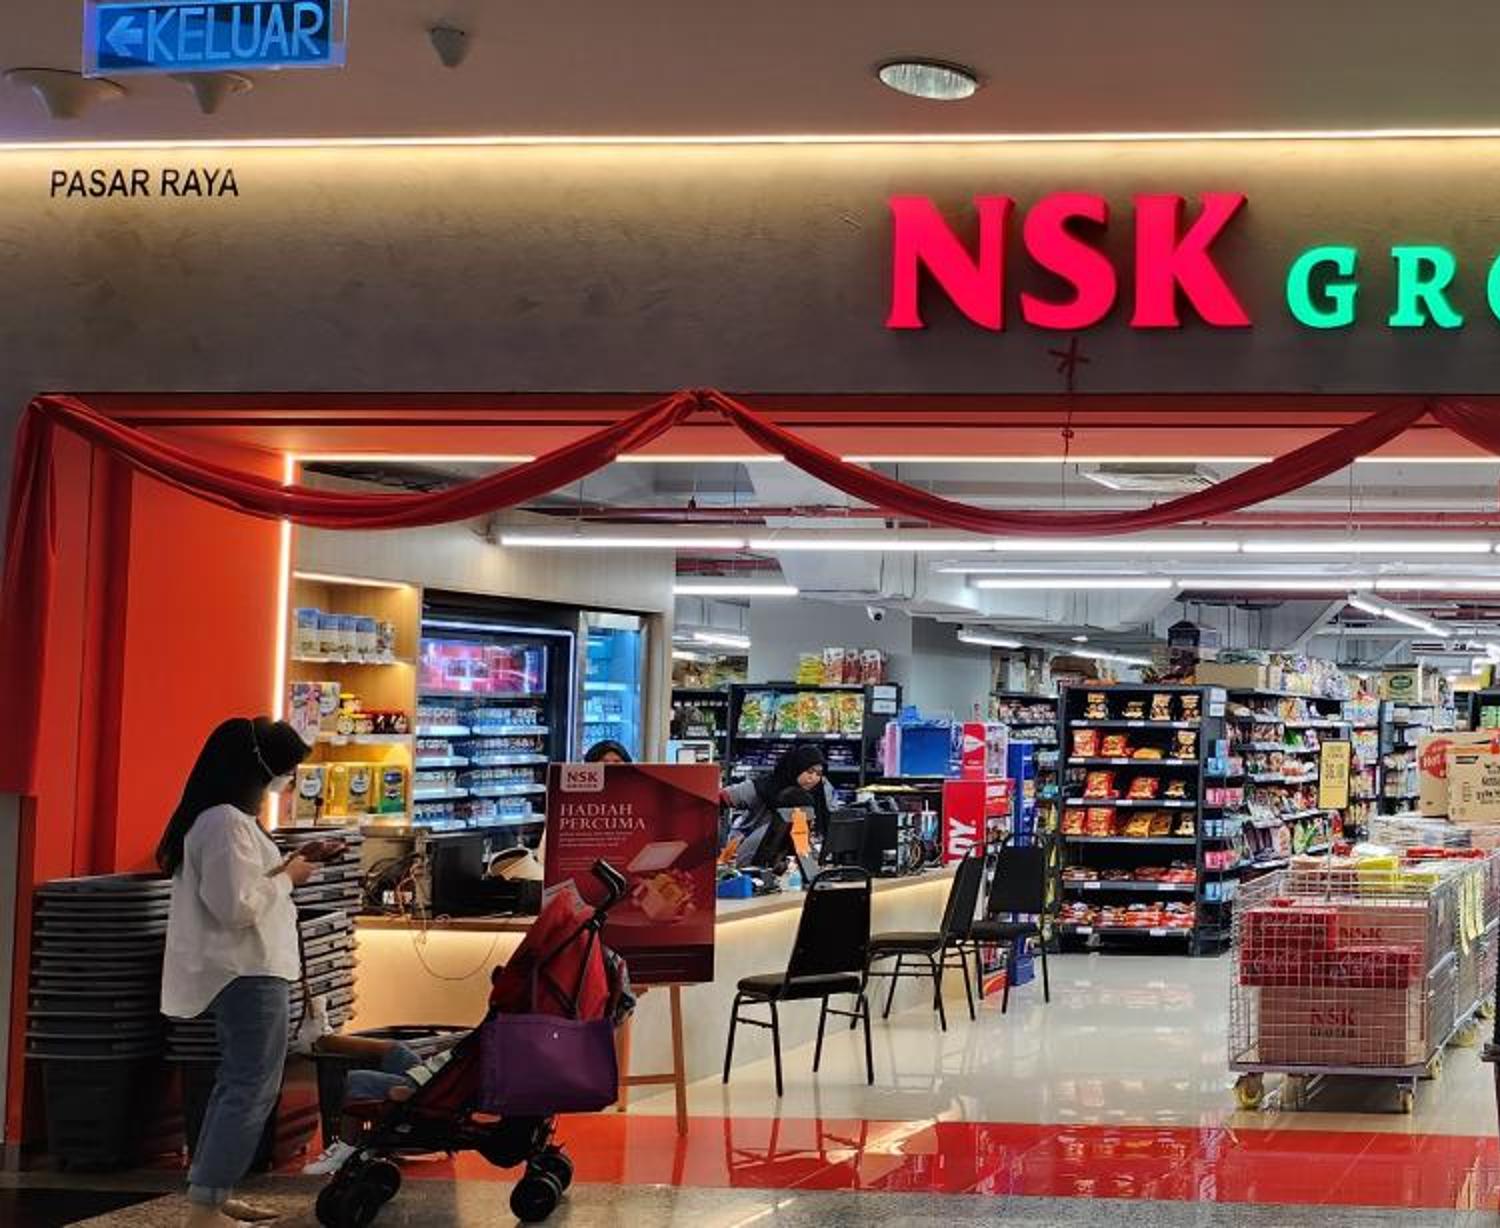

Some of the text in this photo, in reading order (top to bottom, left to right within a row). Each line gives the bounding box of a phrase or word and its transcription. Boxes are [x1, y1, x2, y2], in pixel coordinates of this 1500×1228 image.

[147, 2, 322, 62] KELUAR
[51, 168, 239, 197] PASAR RAYA
[886, 191, 1252, 331] NSK
[567, 771, 598, 782] NSK
[560, 803, 632, 816] HADIAH
[559, 817, 645, 830] PERCUMA
